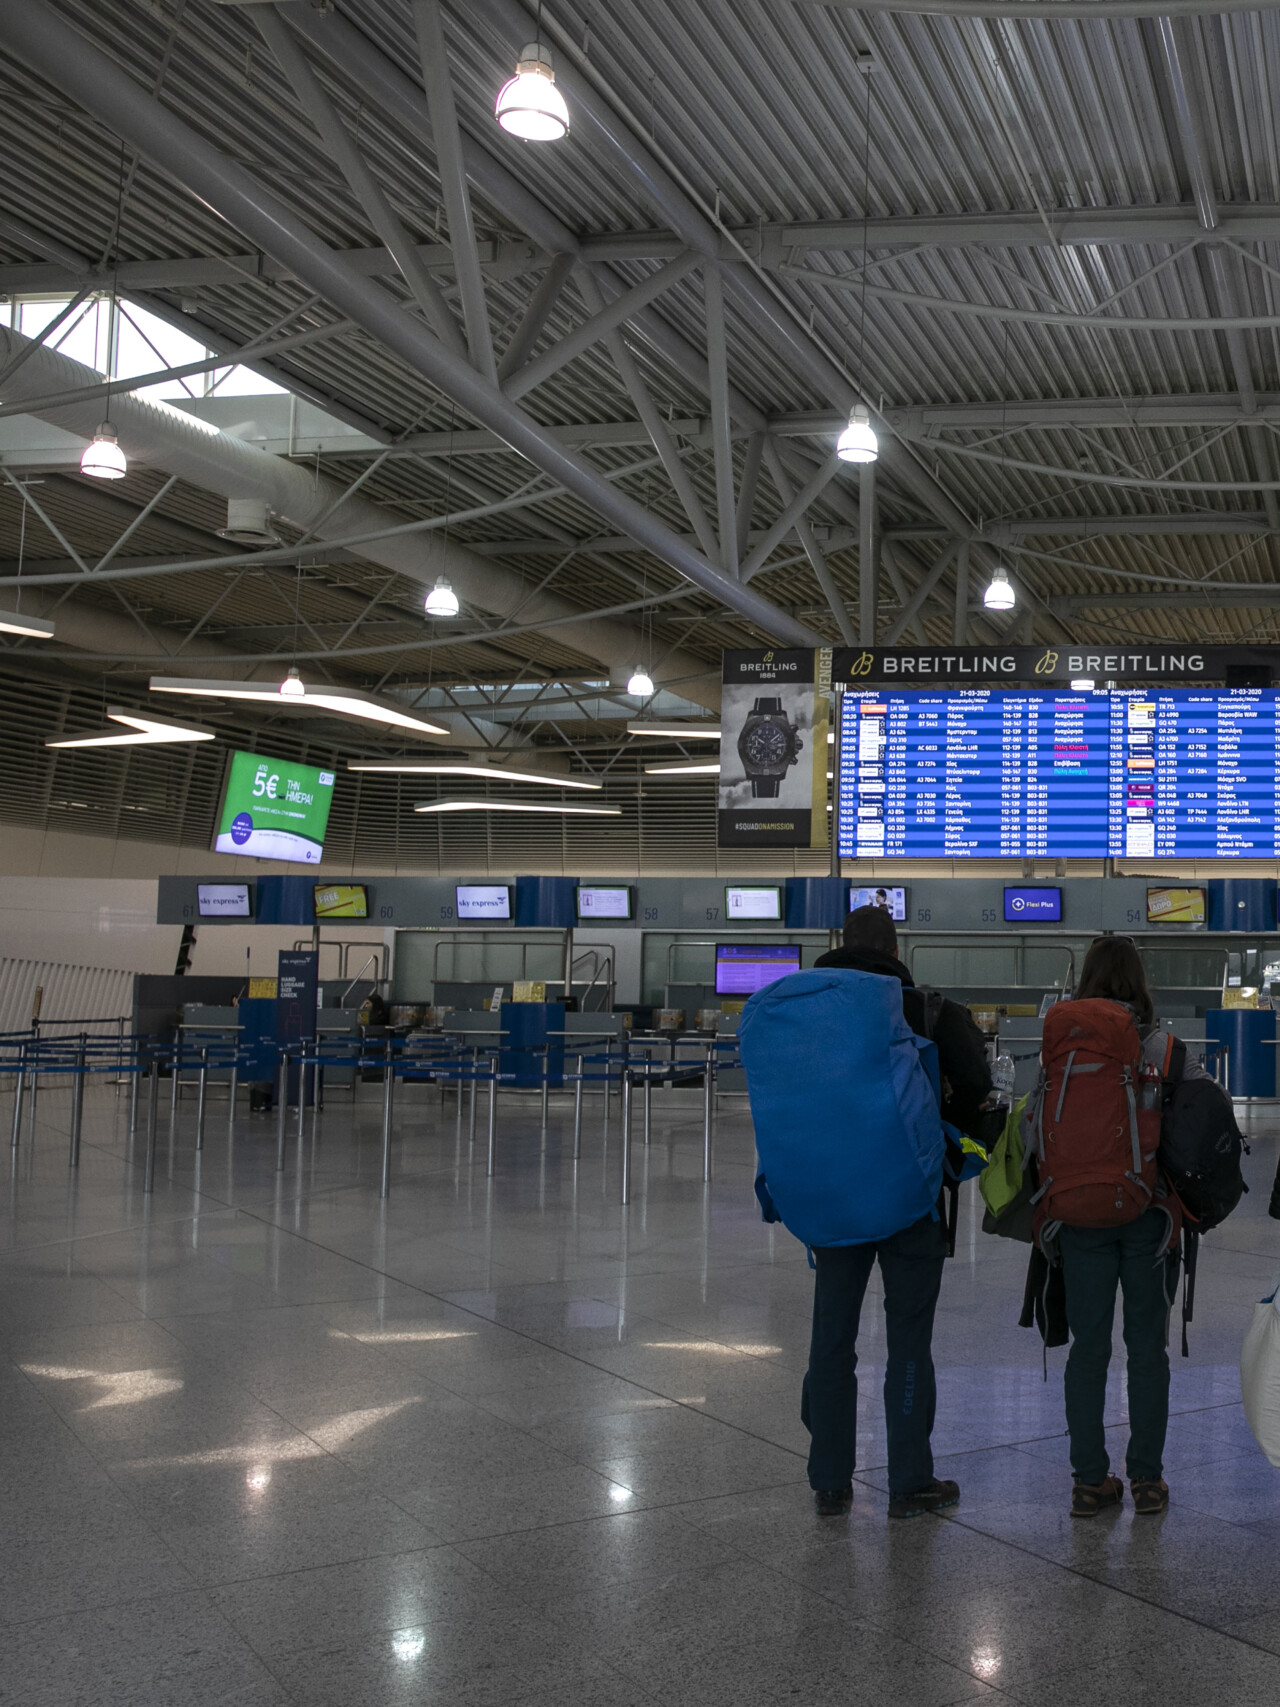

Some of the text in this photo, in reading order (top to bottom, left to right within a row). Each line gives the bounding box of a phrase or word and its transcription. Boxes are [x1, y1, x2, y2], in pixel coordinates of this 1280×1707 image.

[740, 663, 798, 672] BREITLING
[883, 656, 1016, 673] BREITLING
[1068, 655, 1204, 672] BREITLING
[960, 689, 990, 697] 21-03-2020
[252, 771, 279, 799] 5€
[735, 822, 794, 831] #SQUADONAMISSION
[200, 896, 212, 905] sky
[459, 899, 470, 908] sky
[380, 907, 393, 918] 60
[440, 907, 453, 919] 59
[644, 907, 658, 920] 58
[706, 908, 719, 920] 57
[917, 909, 931, 922] 56
[982, 909, 996, 922] 55
[1126, 910, 1141, 923] 54
